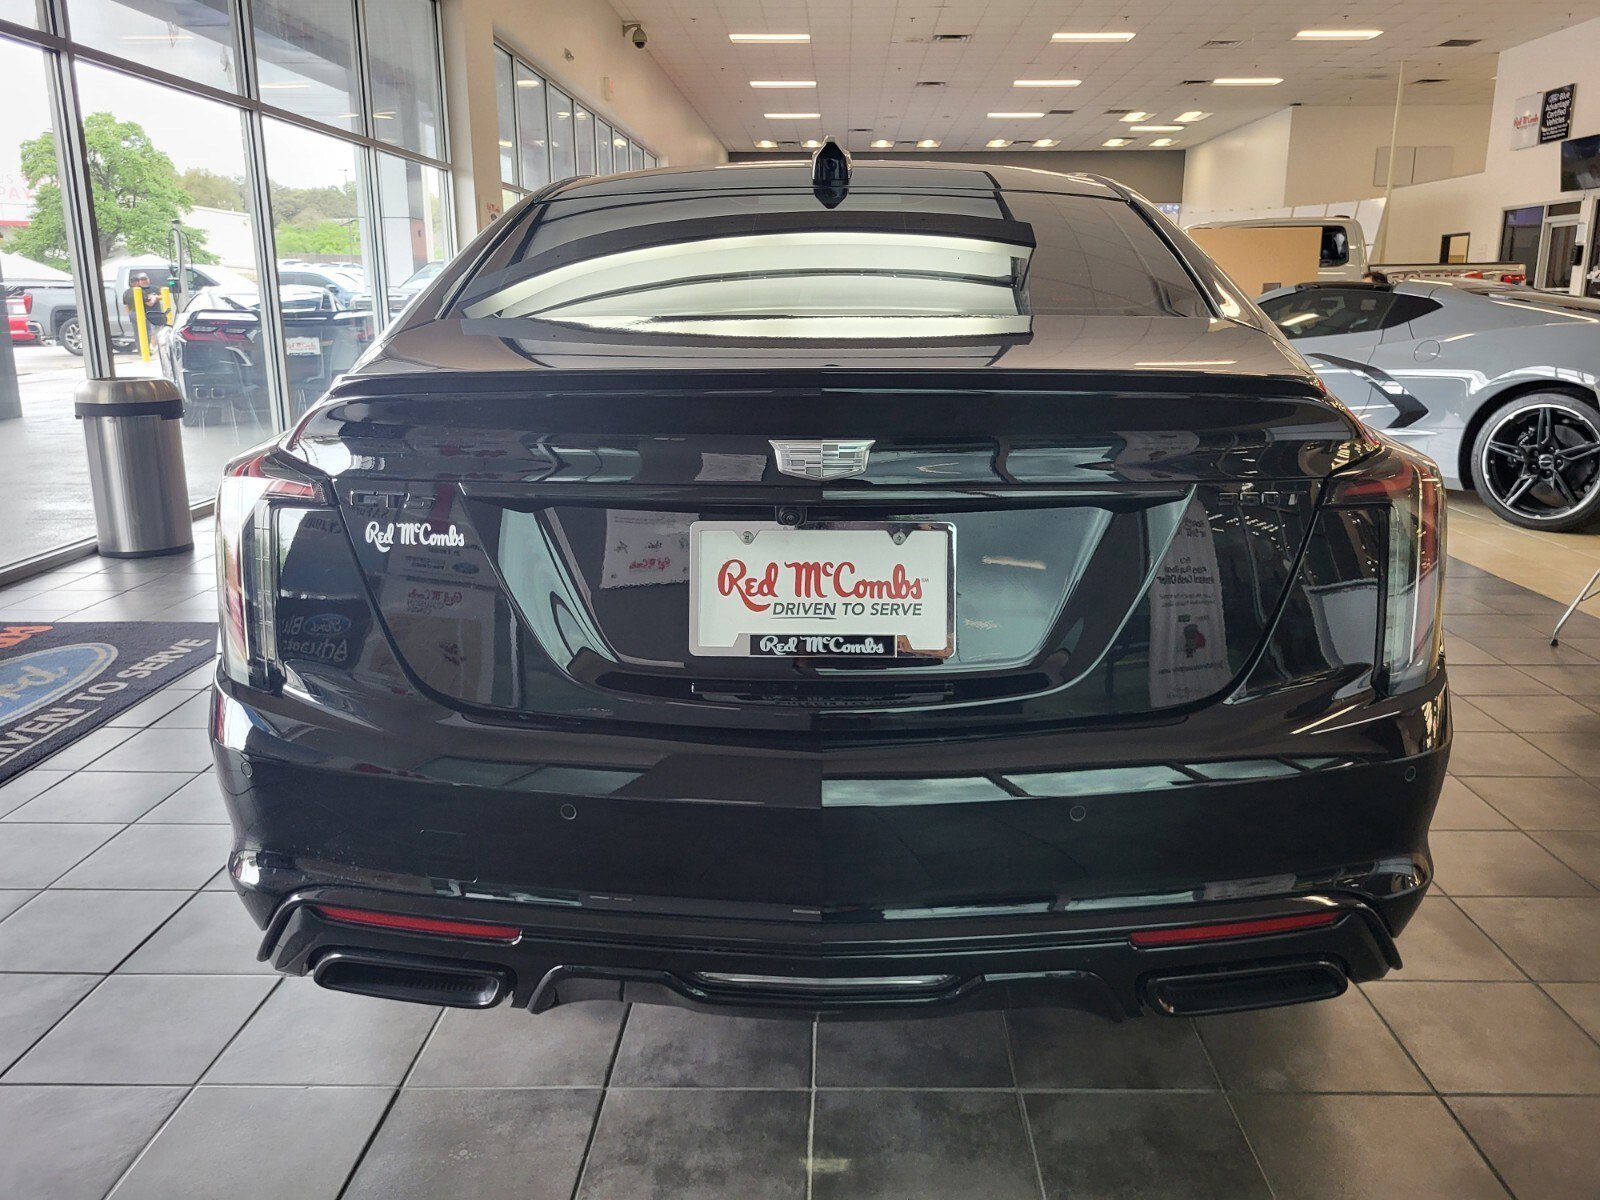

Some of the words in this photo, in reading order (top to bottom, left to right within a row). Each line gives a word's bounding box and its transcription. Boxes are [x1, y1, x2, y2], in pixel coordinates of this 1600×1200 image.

[365, 521, 395, 552] Red
[396, 521, 465, 547] McCombs
[717, 558, 779, 613] Red
[784, 560, 923, 600] McCombs
[772, 602, 837, 616] DRIVEN
[841, 602, 865, 616] TO
[870, 602, 923, 616] SERVE
[759, 635, 798, 655] Red
[800, 635, 885, 654] McCombs
[66, 681, 130, 705] TO
[116, 638, 212, 679] SERVE
